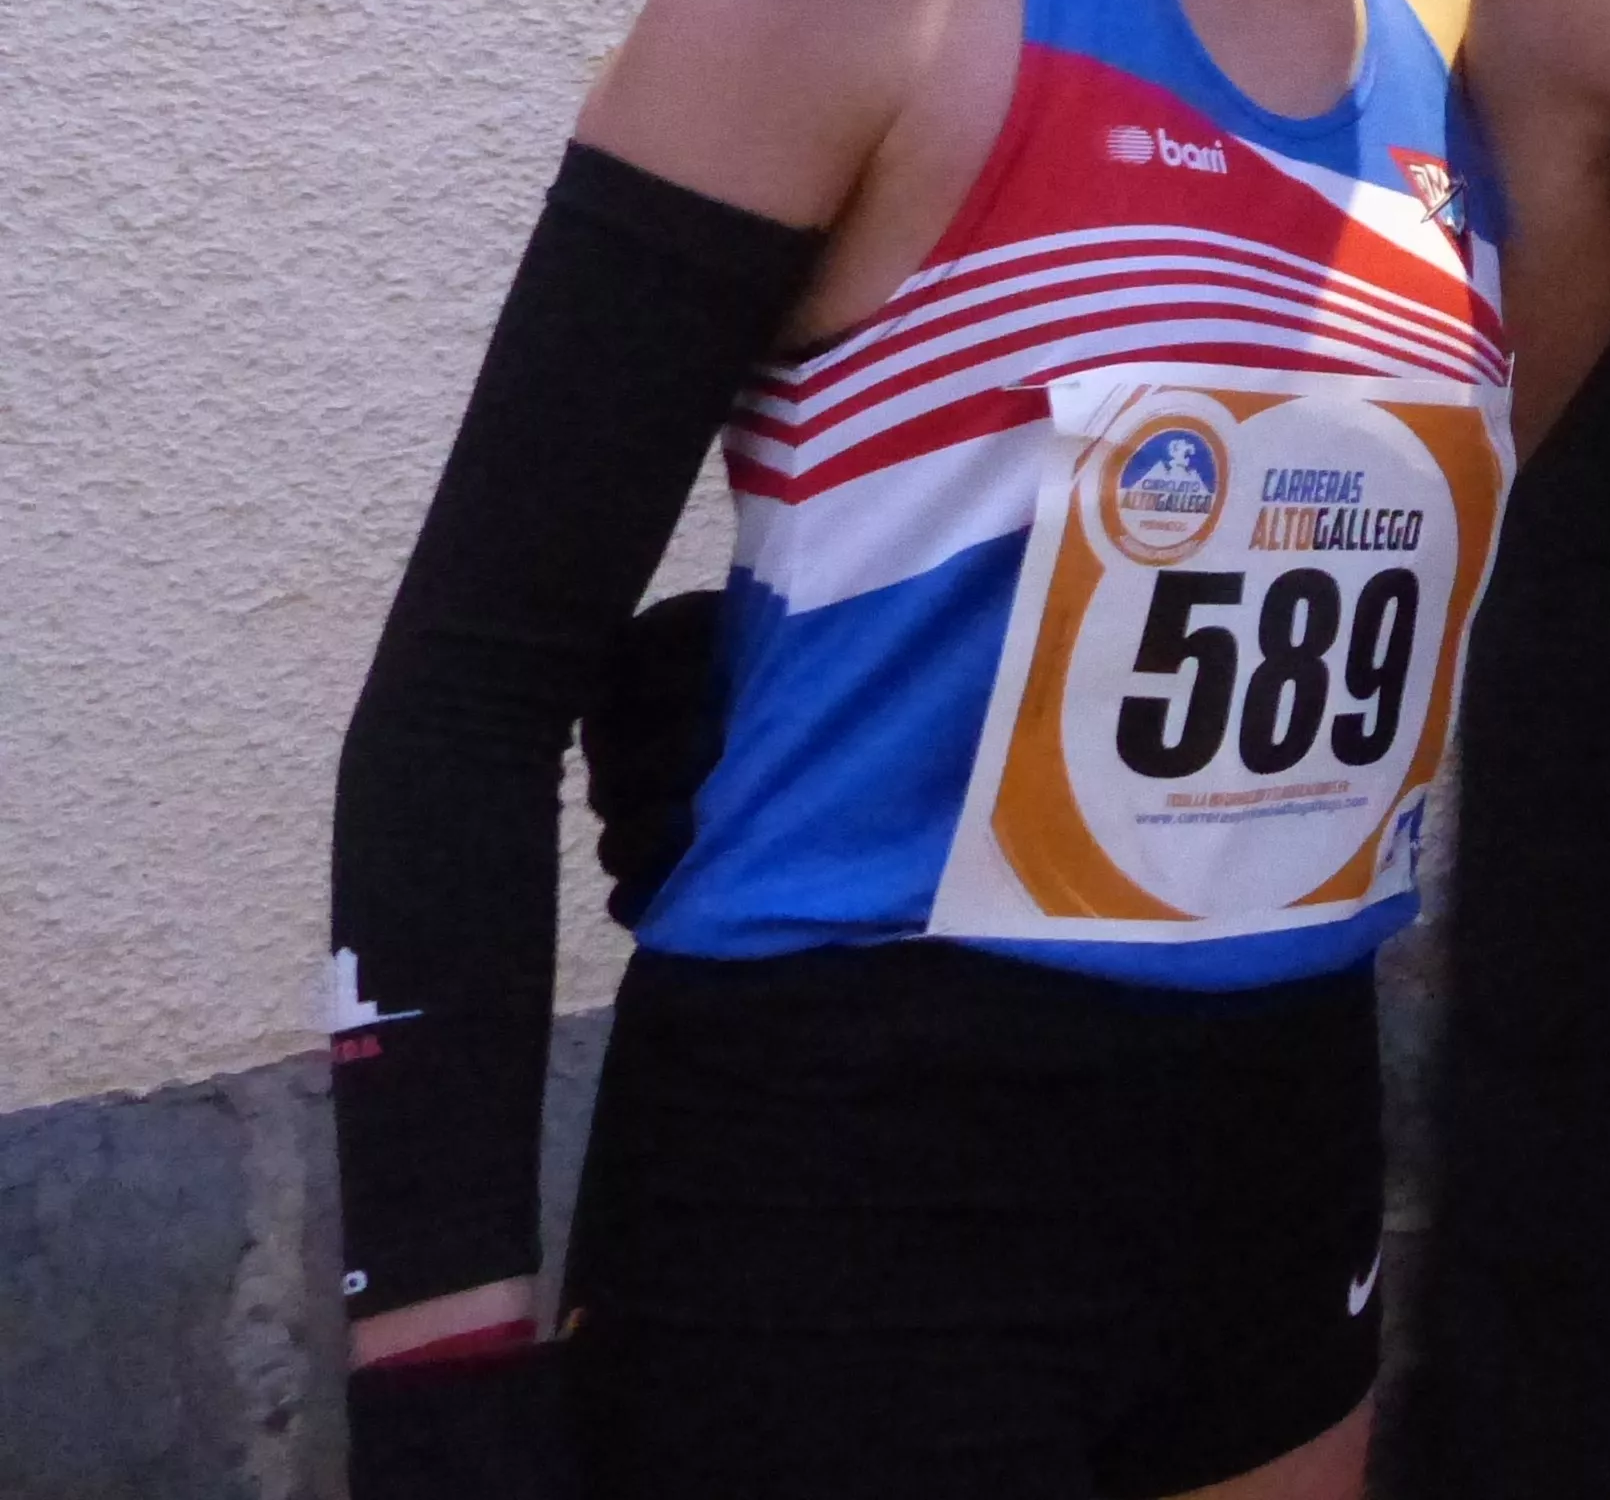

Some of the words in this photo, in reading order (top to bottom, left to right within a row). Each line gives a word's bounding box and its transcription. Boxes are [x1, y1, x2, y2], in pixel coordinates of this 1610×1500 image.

[1157, 128, 1229, 175] barri
[1261, 468, 1366, 505] CARRERAS
[1249, 506, 1424, 552] ALTOGALLEGO
[1116, 567, 1420, 779] 589
